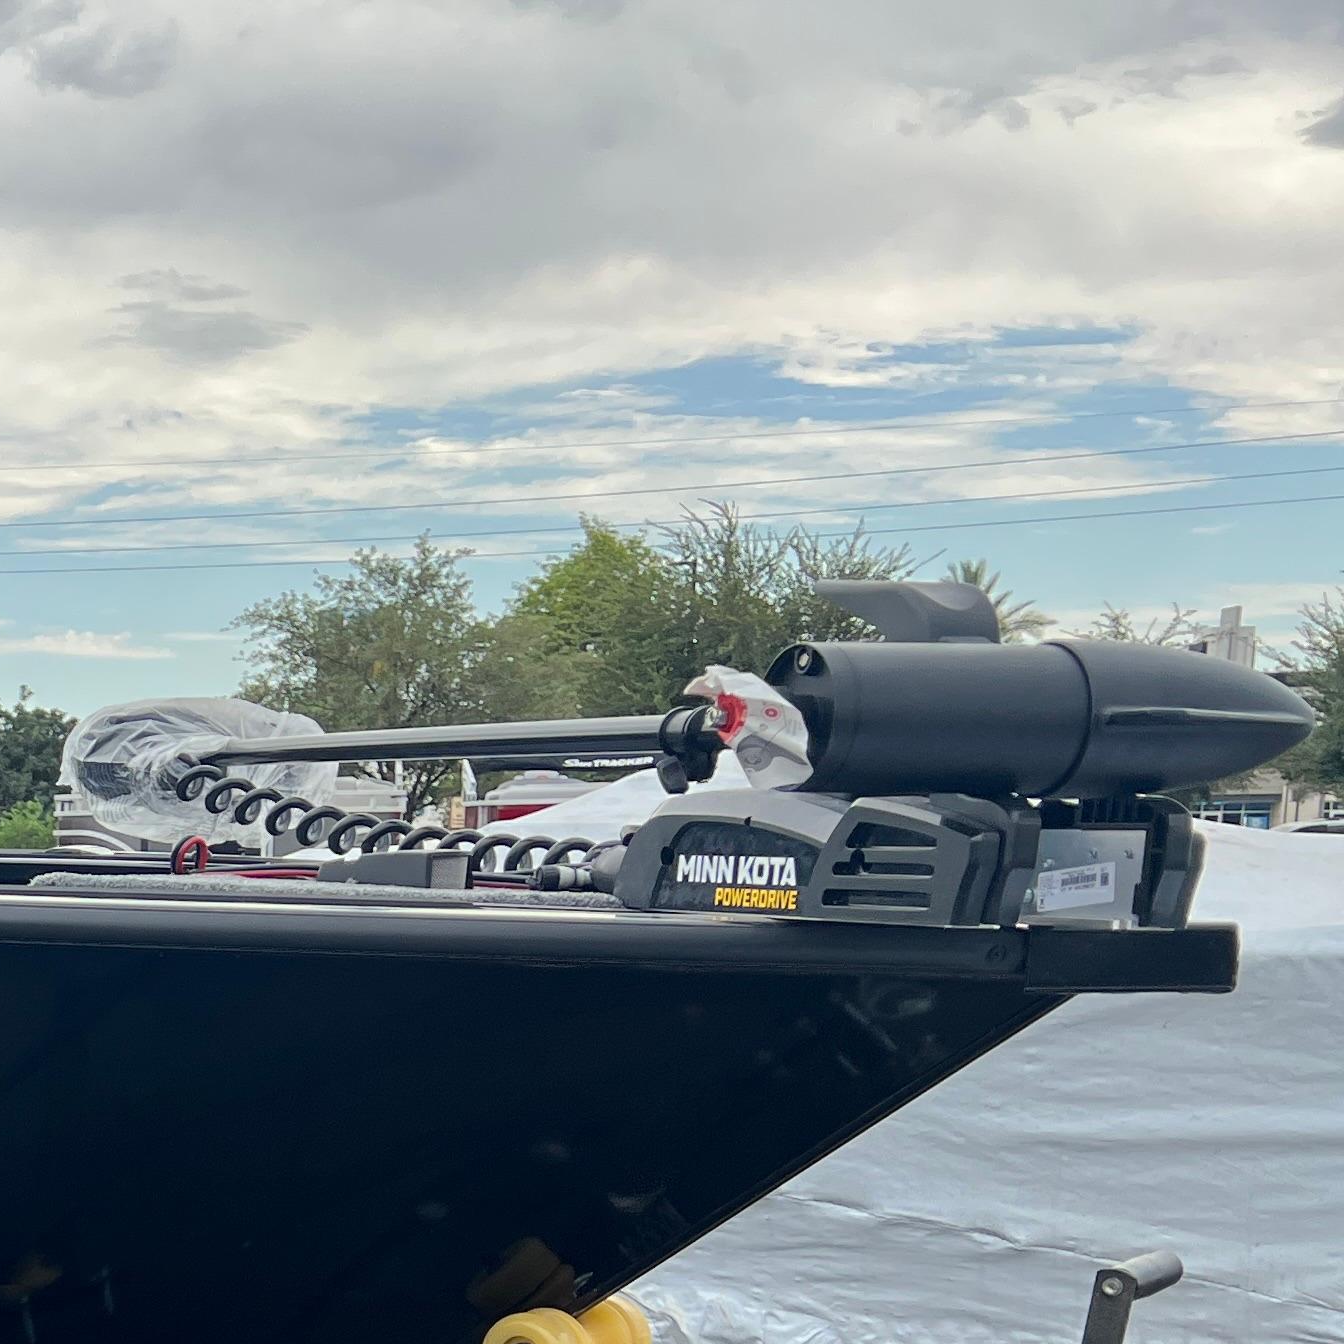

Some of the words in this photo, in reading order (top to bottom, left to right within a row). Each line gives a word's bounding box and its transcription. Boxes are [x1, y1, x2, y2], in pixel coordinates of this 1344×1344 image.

[676, 854, 735, 883] MINN
[737, 856, 797, 887] KOTA
[714, 887, 798, 910] POWERDRIVE
